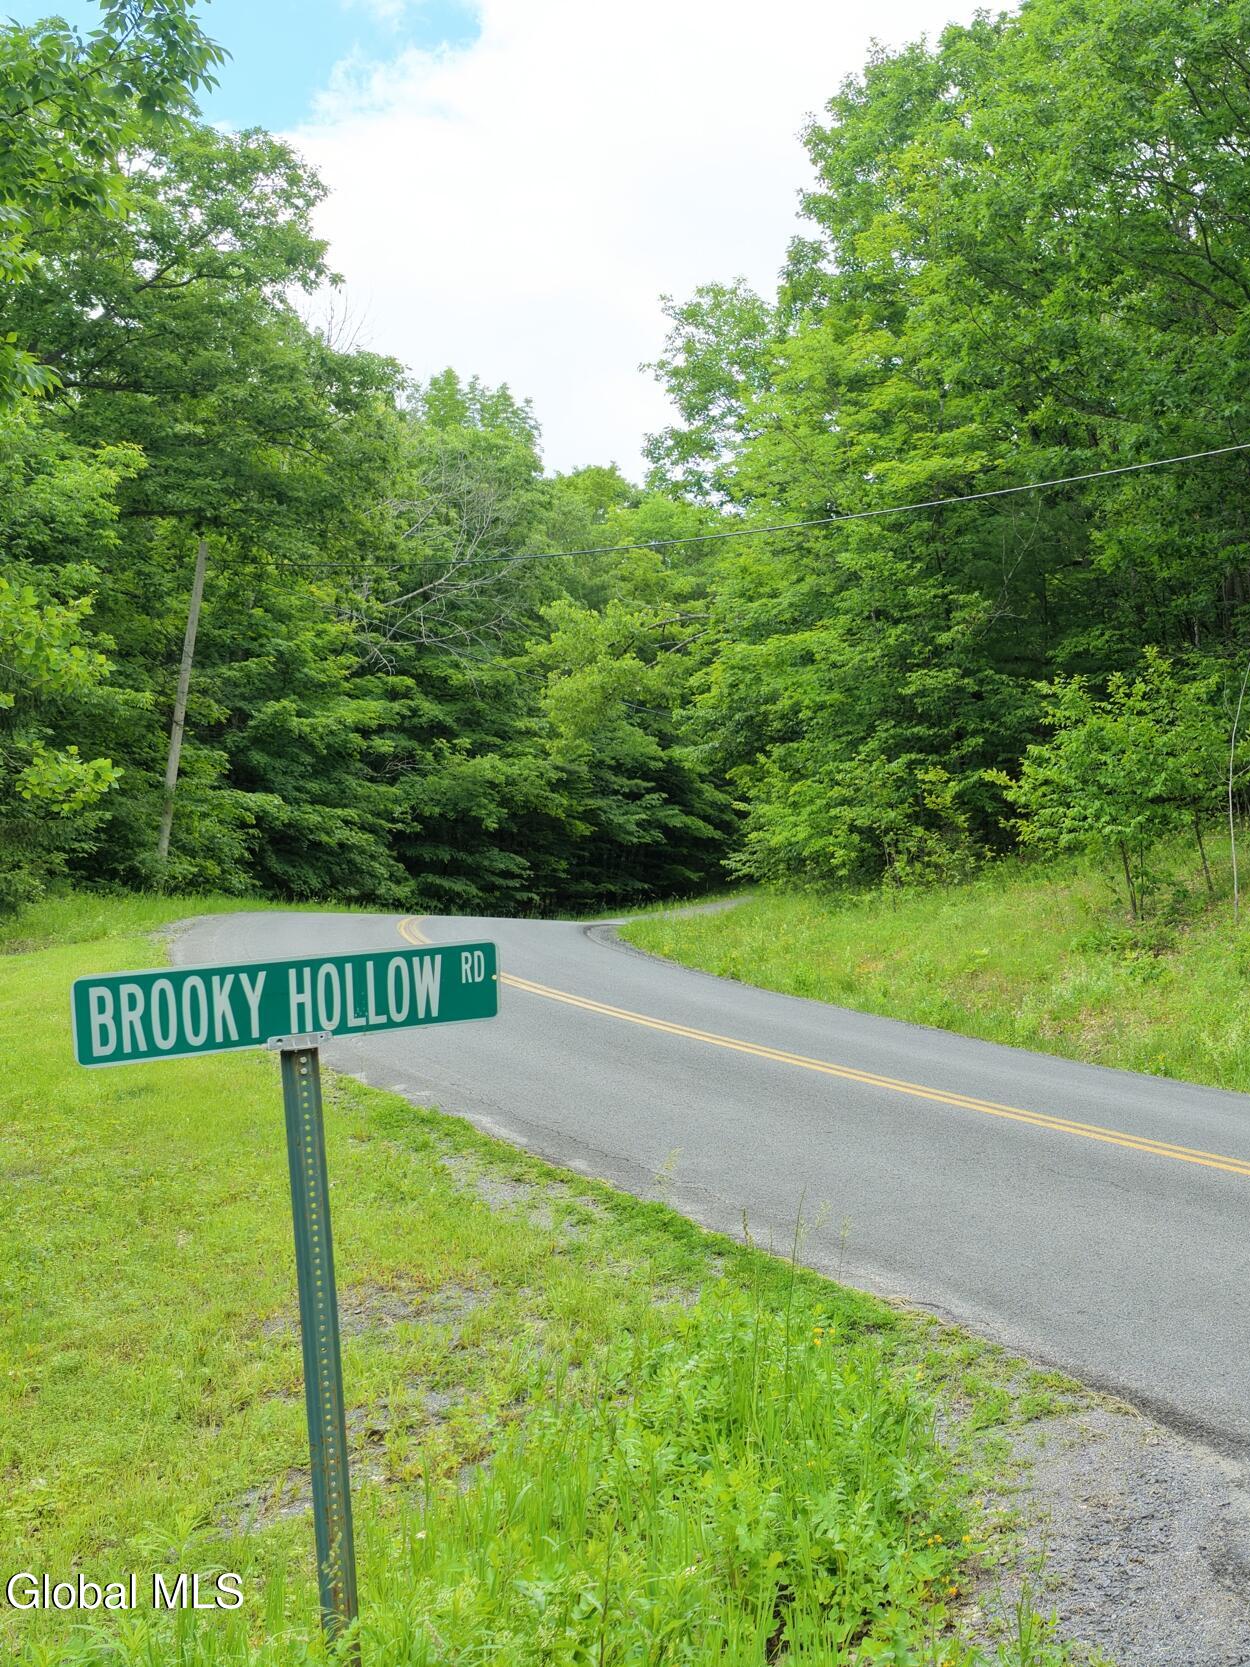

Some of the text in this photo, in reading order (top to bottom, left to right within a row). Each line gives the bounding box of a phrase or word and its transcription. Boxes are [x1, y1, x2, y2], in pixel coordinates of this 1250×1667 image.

[88, 950, 486, 1057] BROOKY HOLLOW RD
